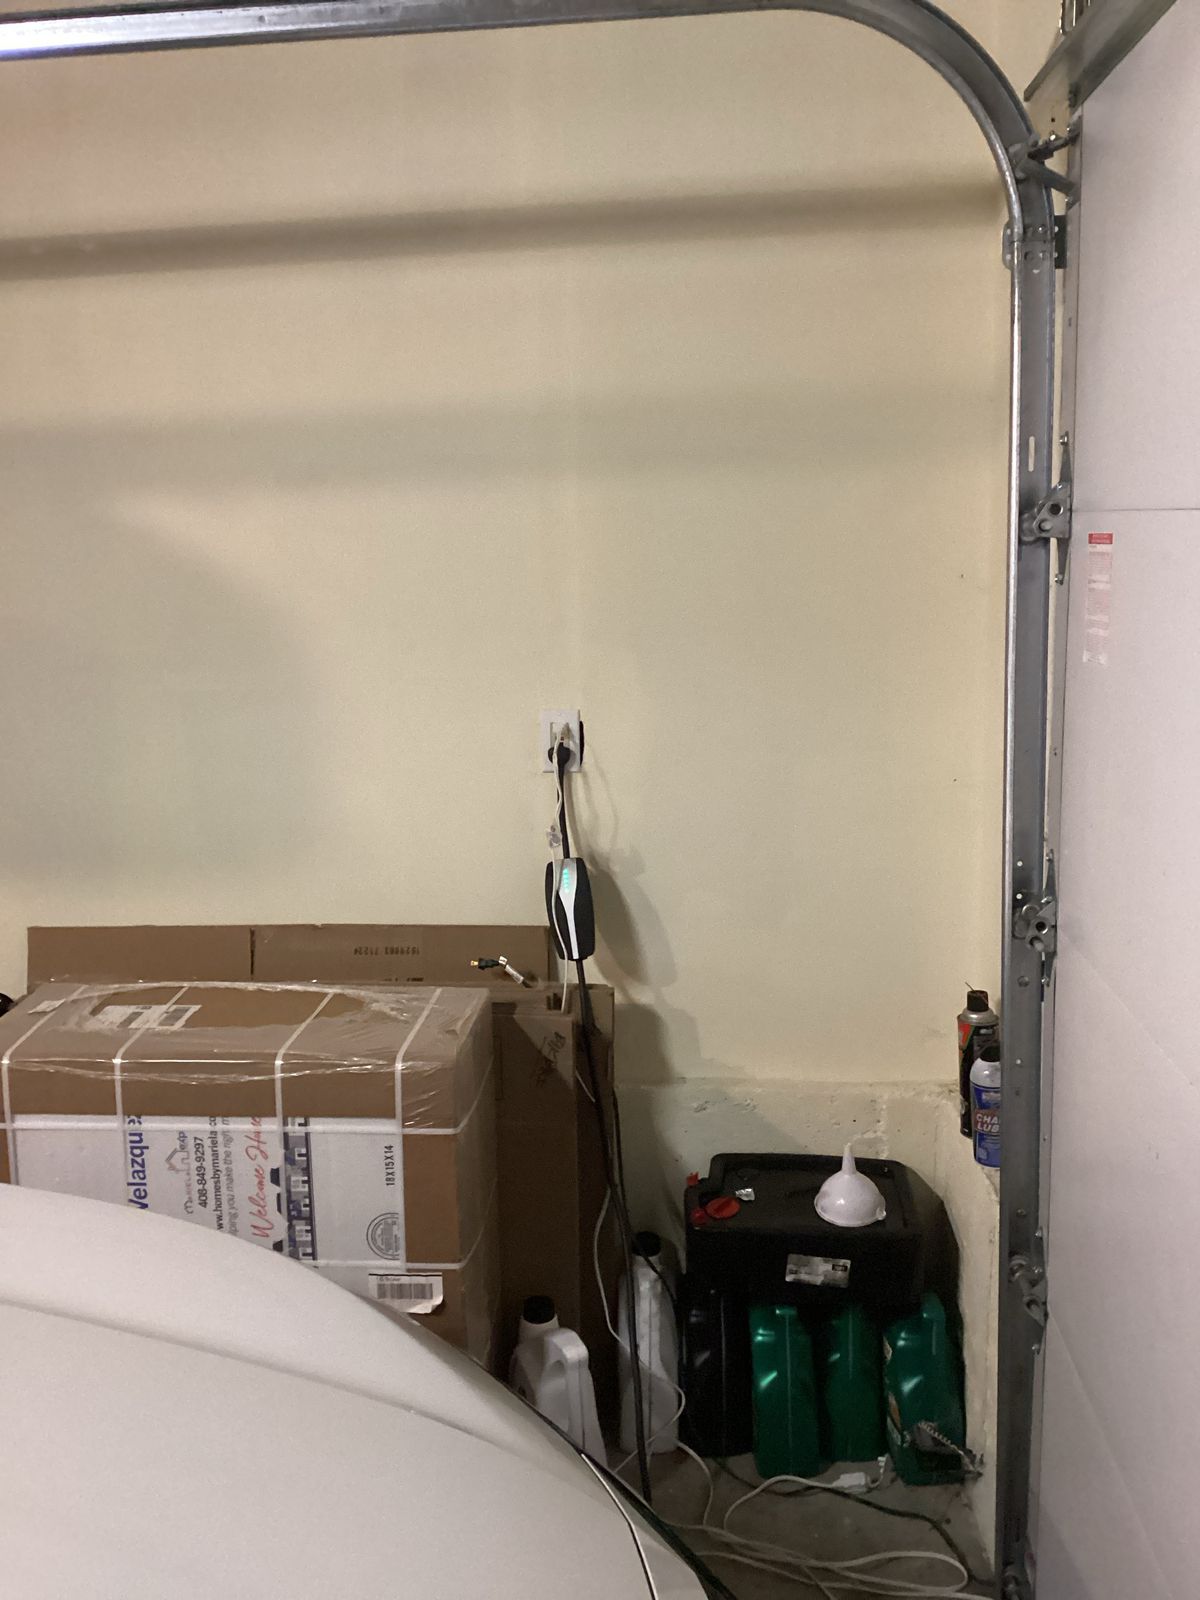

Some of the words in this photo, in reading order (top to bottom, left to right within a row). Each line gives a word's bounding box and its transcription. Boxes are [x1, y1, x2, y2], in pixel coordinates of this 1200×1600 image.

[221, 1127, 234, 1148] righ
[222, 1149, 232, 1165] the
[384, 1144, 396, 1187] 18X15X14
[193, 1136, 208, 1208] 408-849-9297
[223, 1166, 234, 1193] make
[228, 1194, 239, 1212] you
[248, 1165, 274, 1238] Welcome
